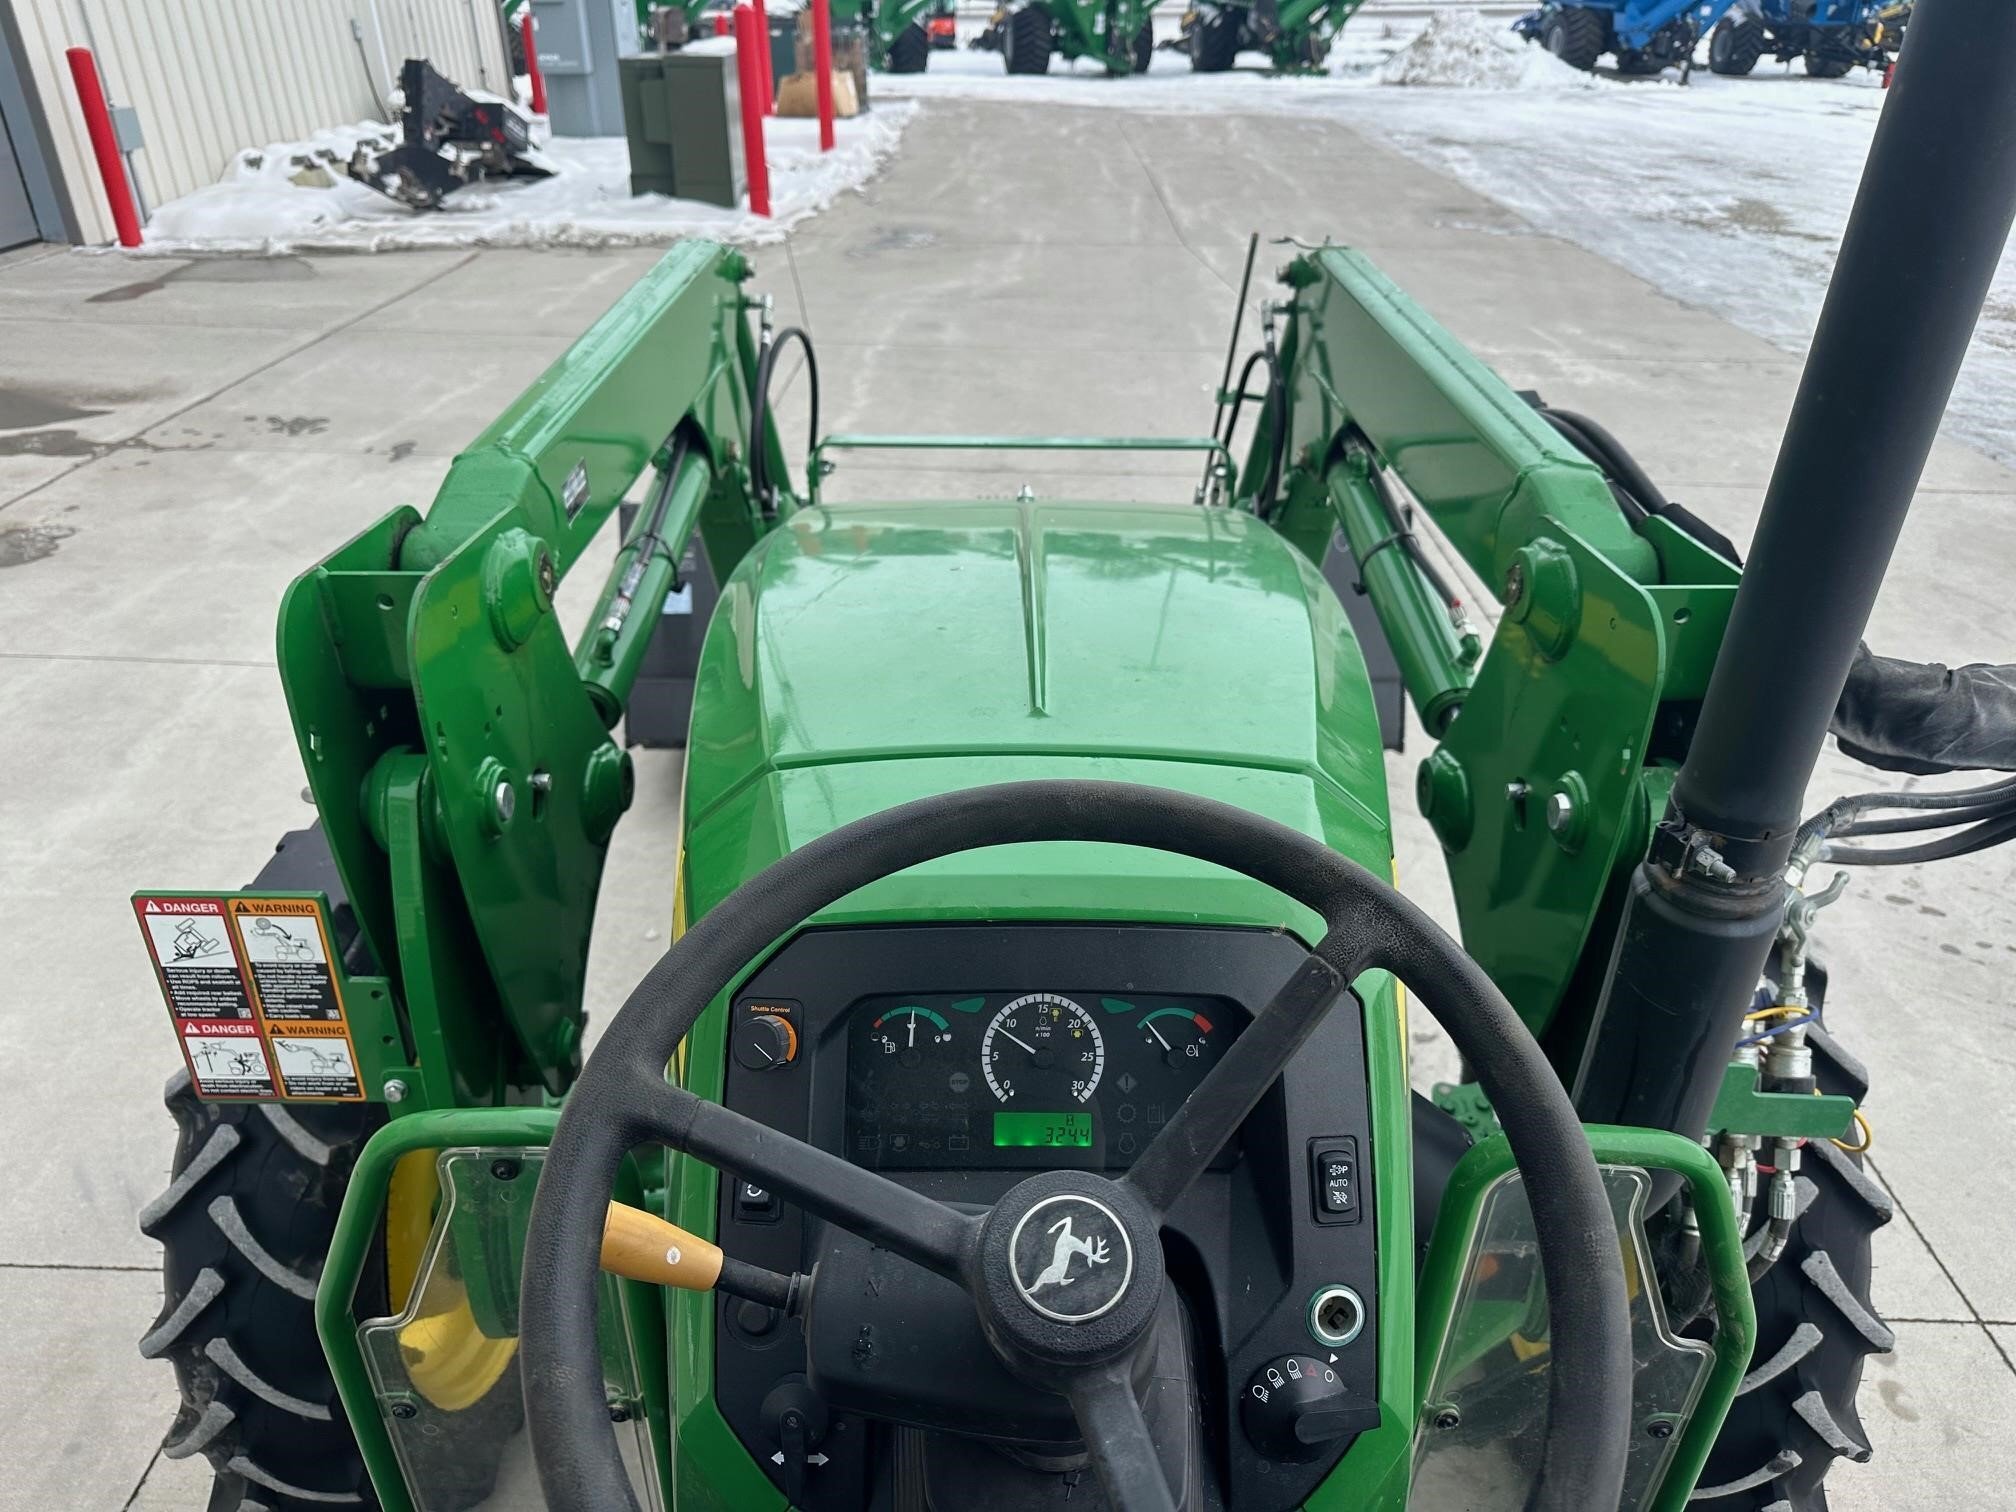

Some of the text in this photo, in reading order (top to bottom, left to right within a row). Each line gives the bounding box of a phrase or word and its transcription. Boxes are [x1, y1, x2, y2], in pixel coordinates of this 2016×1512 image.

[163, 902, 219, 913] DANGER
[252, 904, 316, 913] WARNING
[1037, 1004, 1049, 1014] 15
[1005, 1018, 1017, 1028] 10
[1067, 1018, 1081, 1028] 20
[201, 1024, 256, 1034] DANGER
[285, 1026, 347, 1035] WARNING
[992, 1052, 999, 1061] 5
[1080, 1052, 1094, 1062] 25
[1003, 1080, 1011, 1090] 0
[1071, 1080, 1085, 1090] 30
[1330, 1179, 1348, 1188] AUTO
